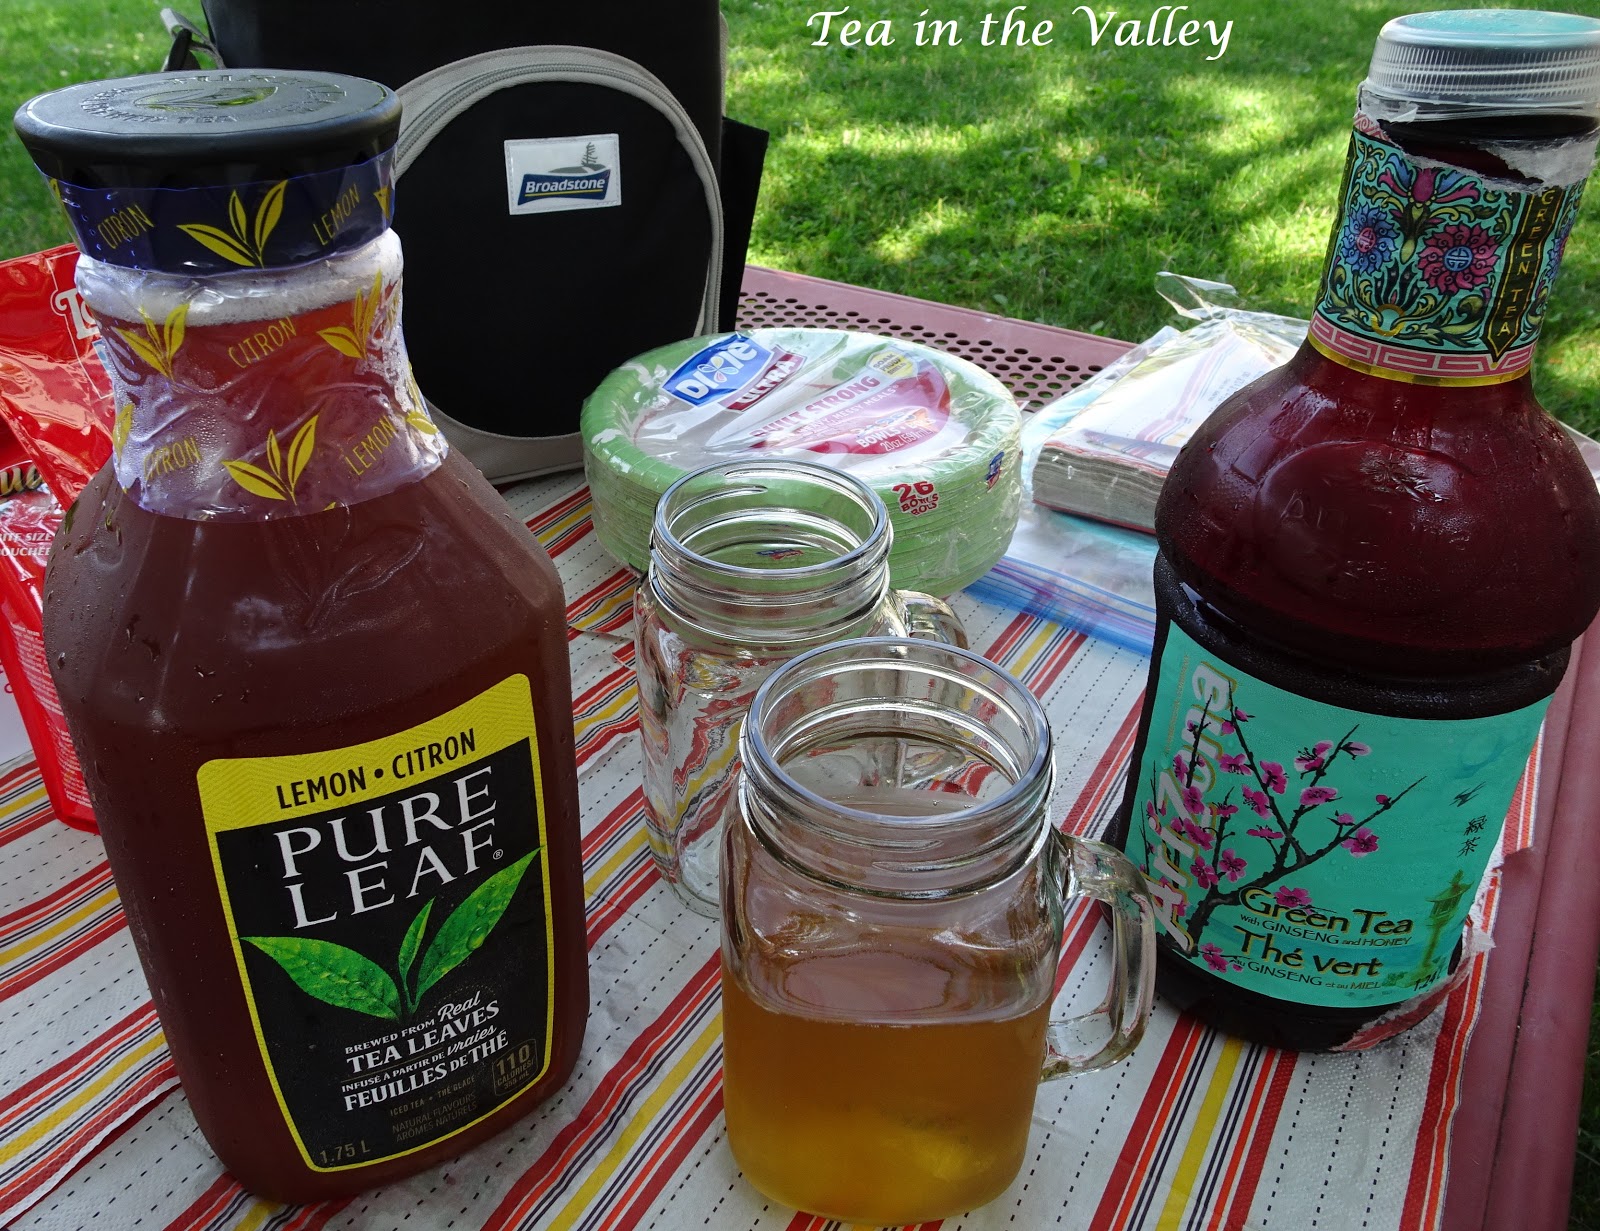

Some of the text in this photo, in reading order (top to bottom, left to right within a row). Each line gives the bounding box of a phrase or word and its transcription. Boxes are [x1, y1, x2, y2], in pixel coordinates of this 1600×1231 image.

[525, 178, 606, 193] Broadstone
[312, 183, 361, 246] LEMON
[1497, 189, 1555, 336] GREEN TEA
[228, 316, 297, 369] CITRON
[872, 353, 896, 369] SOAK
[733, 360, 797, 404] ULTRA
[805, 374, 881, 415] STRONG
[833, 403, 864, 421] MESSY
[345, 414, 398, 477] LEMON
[856, 426, 902, 448] BOWLS
[880, 439, 904, 452] 20oz
[892, 480, 935, 504] 26
[910, 502, 938, 516] BOLS
[0, 532, 52, 542] ITE SIZE
[276, 727, 477, 810] LEMON CITRON
[273, 765, 498, 879] PURE
[285, 818, 498, 930] LEAF
[1239, 885, 1414, 937] Green Tea
[1233, 924, 1305, 968] Thé
[1262, 920, 1340, 945] GINSENG
[1342, 937, 1361, 946] and
[1361, 936, 1413, 947] HONEY
[1247, 961, 1323, 987] GINSENG
[1350, 981, 1382, 990] MIEL
[344, 990, 481, 1055] BREWED FROM Real
[346, 999, 500, 1074] TEA LEAVES
[341, 1075, 382, 1093] INFUSÉ
[392, 1059, 431, 1078] PARTIR
[431, 1051, 446, 1063] DE
[446, 1024, 498, 1056] vraies
[343, 1029, 509, 1112] FEUILLES DE THÉ
[496, 1044, 530, 1076] 110
[519, 1070, 530, 1080] mL
[390, 1103, 409, 1117] ICED
[410, 1098, 425, 1111] TEA
[392, 1092, 477, 1134] NATURAL FLAVOURS
[435, 1102, 478, 1127] NATURELS
[319, 1139, 371, 1165] 1.75 L
